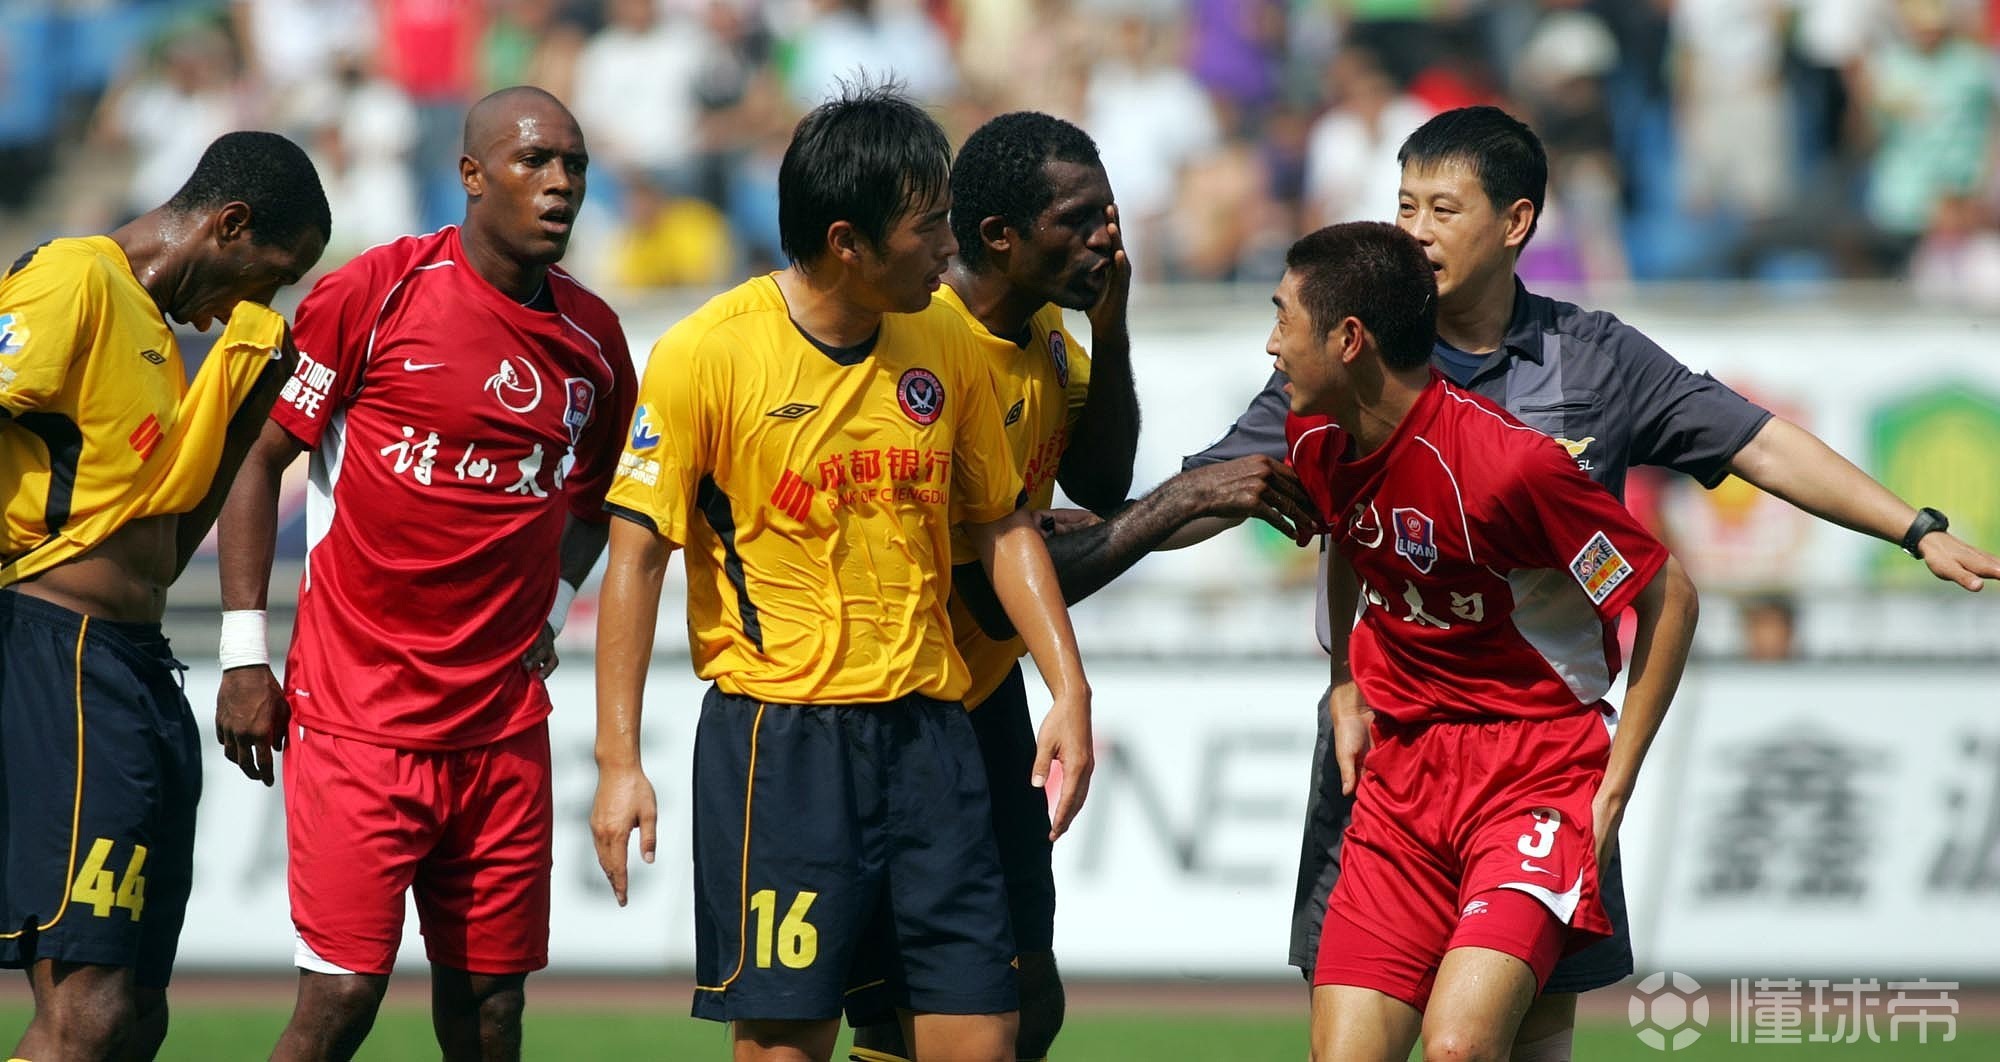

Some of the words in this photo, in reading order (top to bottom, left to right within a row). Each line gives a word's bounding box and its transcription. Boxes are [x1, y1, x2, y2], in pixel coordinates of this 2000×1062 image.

[818, 445, 950, 492] 成都银行
[1576, 459, 1595, 471] SL
[860, 488, 877, 505] OF
[1399, 538, 1434, 557] LIFAN
[1517, 807, 1561, 859] 3
[71, 837, 147, 922] 44
[750, 890, 818, 969] 16
